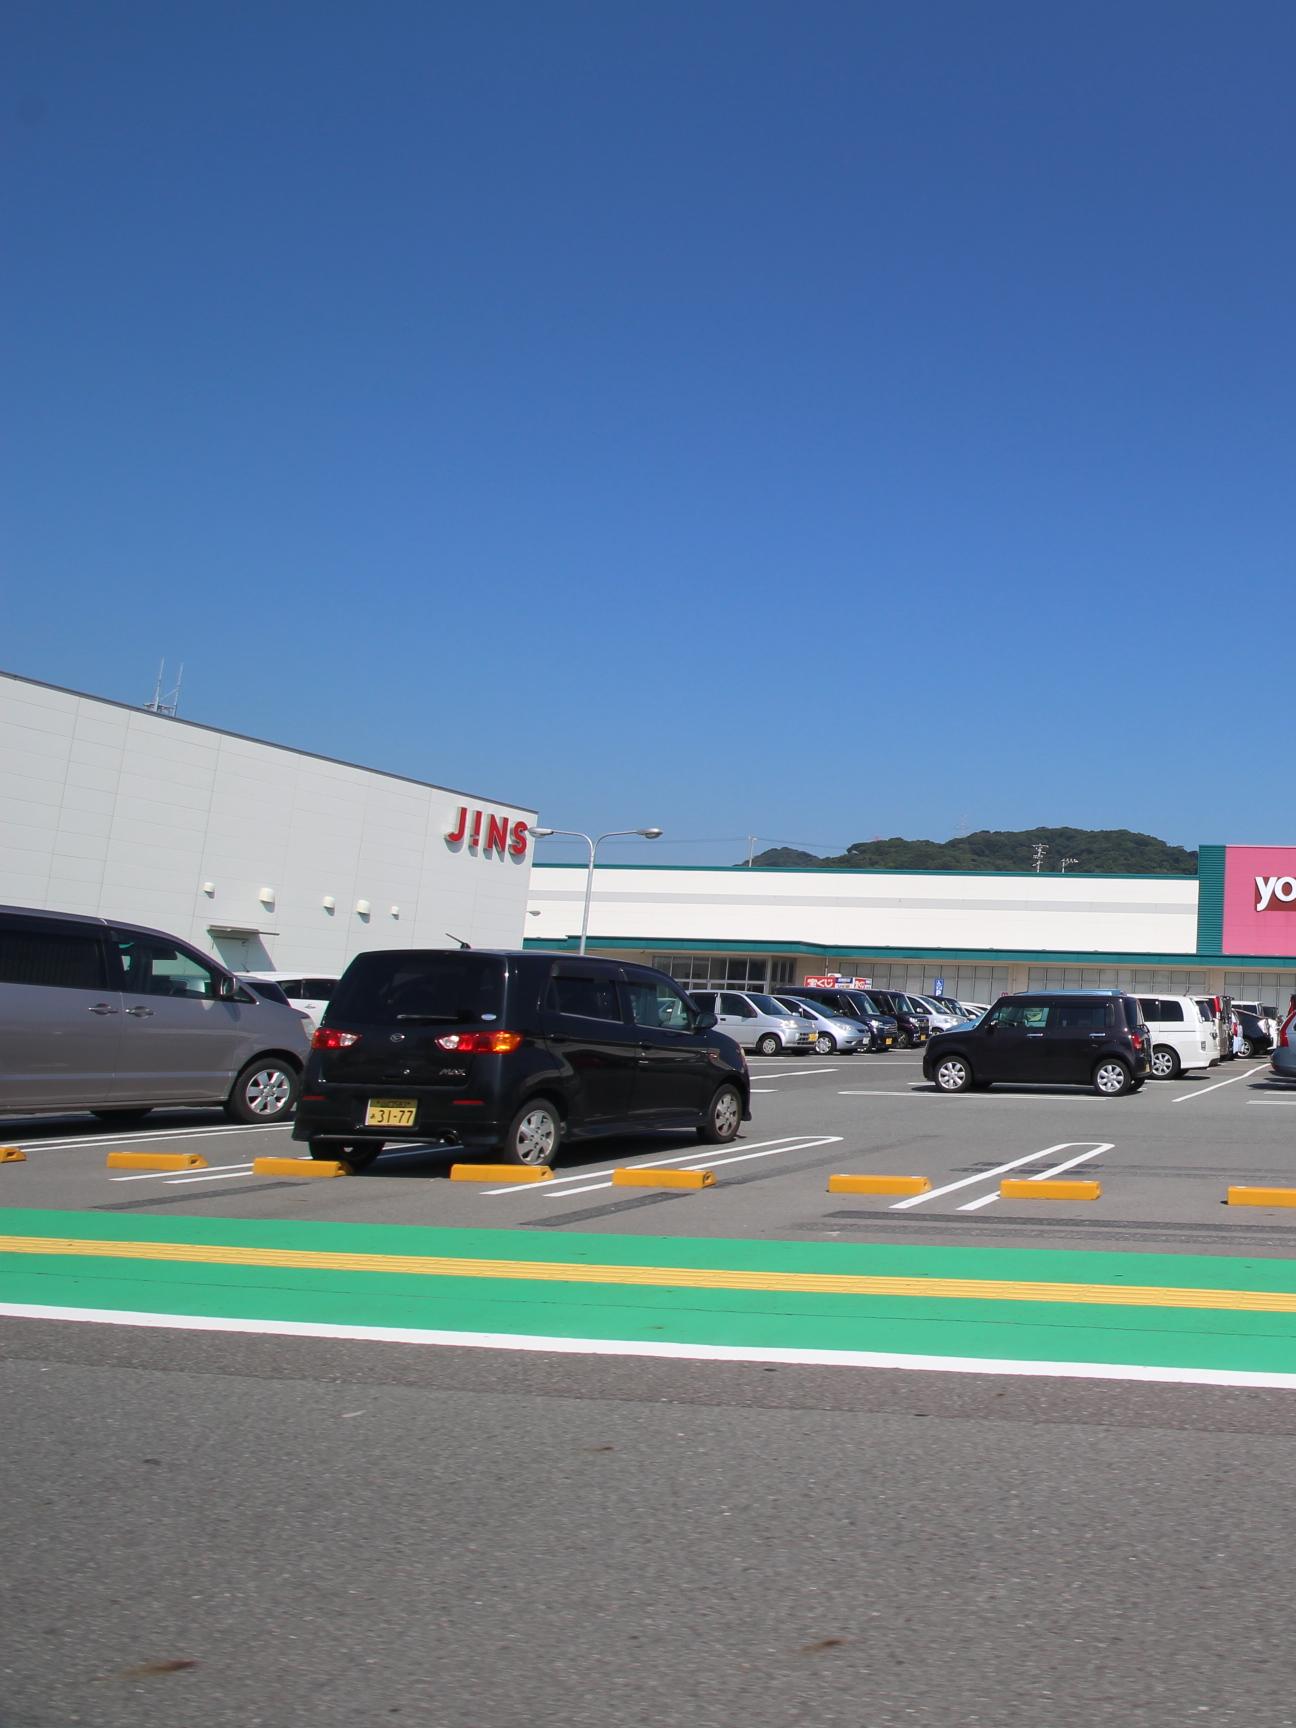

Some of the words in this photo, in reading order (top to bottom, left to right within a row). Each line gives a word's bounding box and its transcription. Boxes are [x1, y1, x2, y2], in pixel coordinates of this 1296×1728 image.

[807, 978, 833, 988] 宝くじ
[377, 1109, 414, 1124] 31-77
